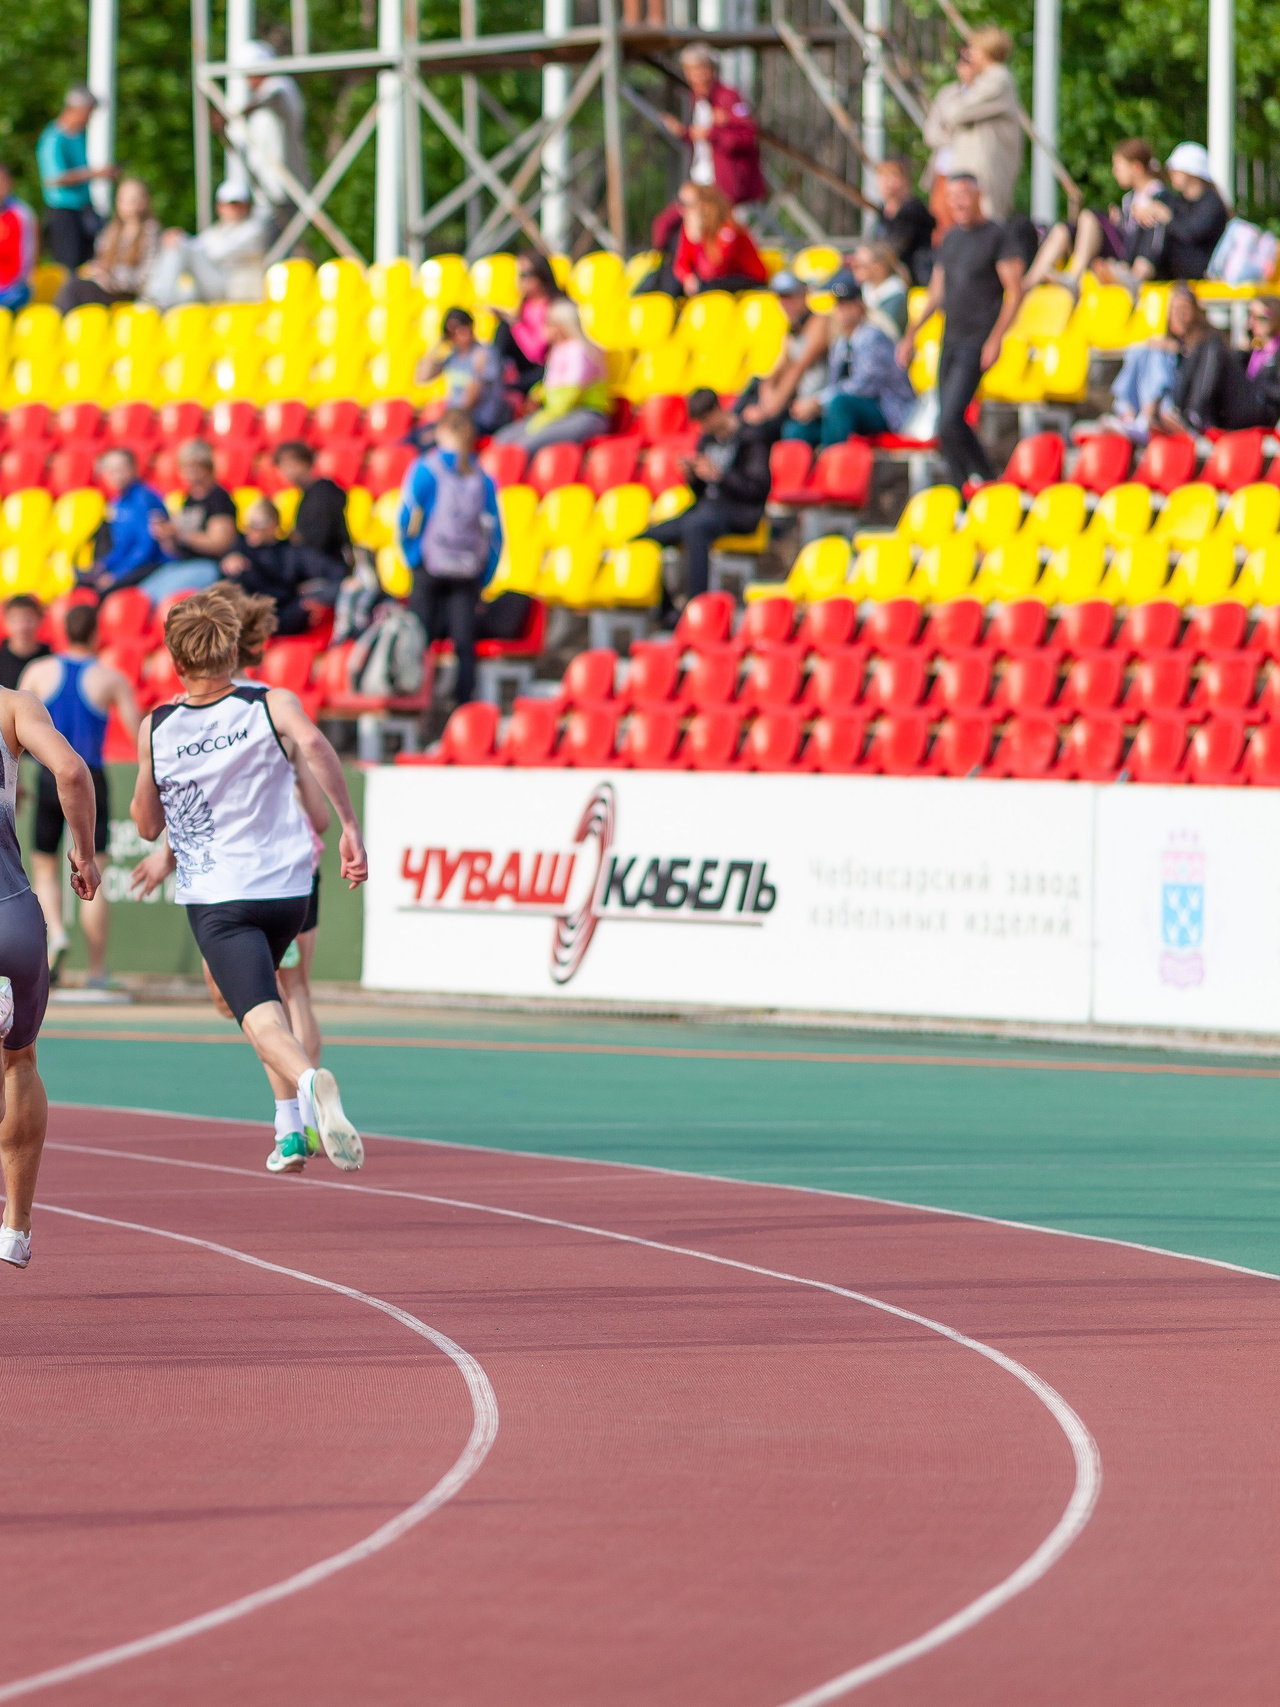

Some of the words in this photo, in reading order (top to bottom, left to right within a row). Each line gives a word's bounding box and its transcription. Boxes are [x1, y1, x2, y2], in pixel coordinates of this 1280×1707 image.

[176, 728, 248, 759] РОССИЯ
[400, 846, 577, 905] ЧУВАШ
[602, 854, 778, 913] КАБЕЛЬ
[809, 855, 992, 898] Чебоксарский
[1006, 868, 1081, 901] завод
[807, 897, 948, 932] кабельных
[963, 902, 1074, 939] изделий
